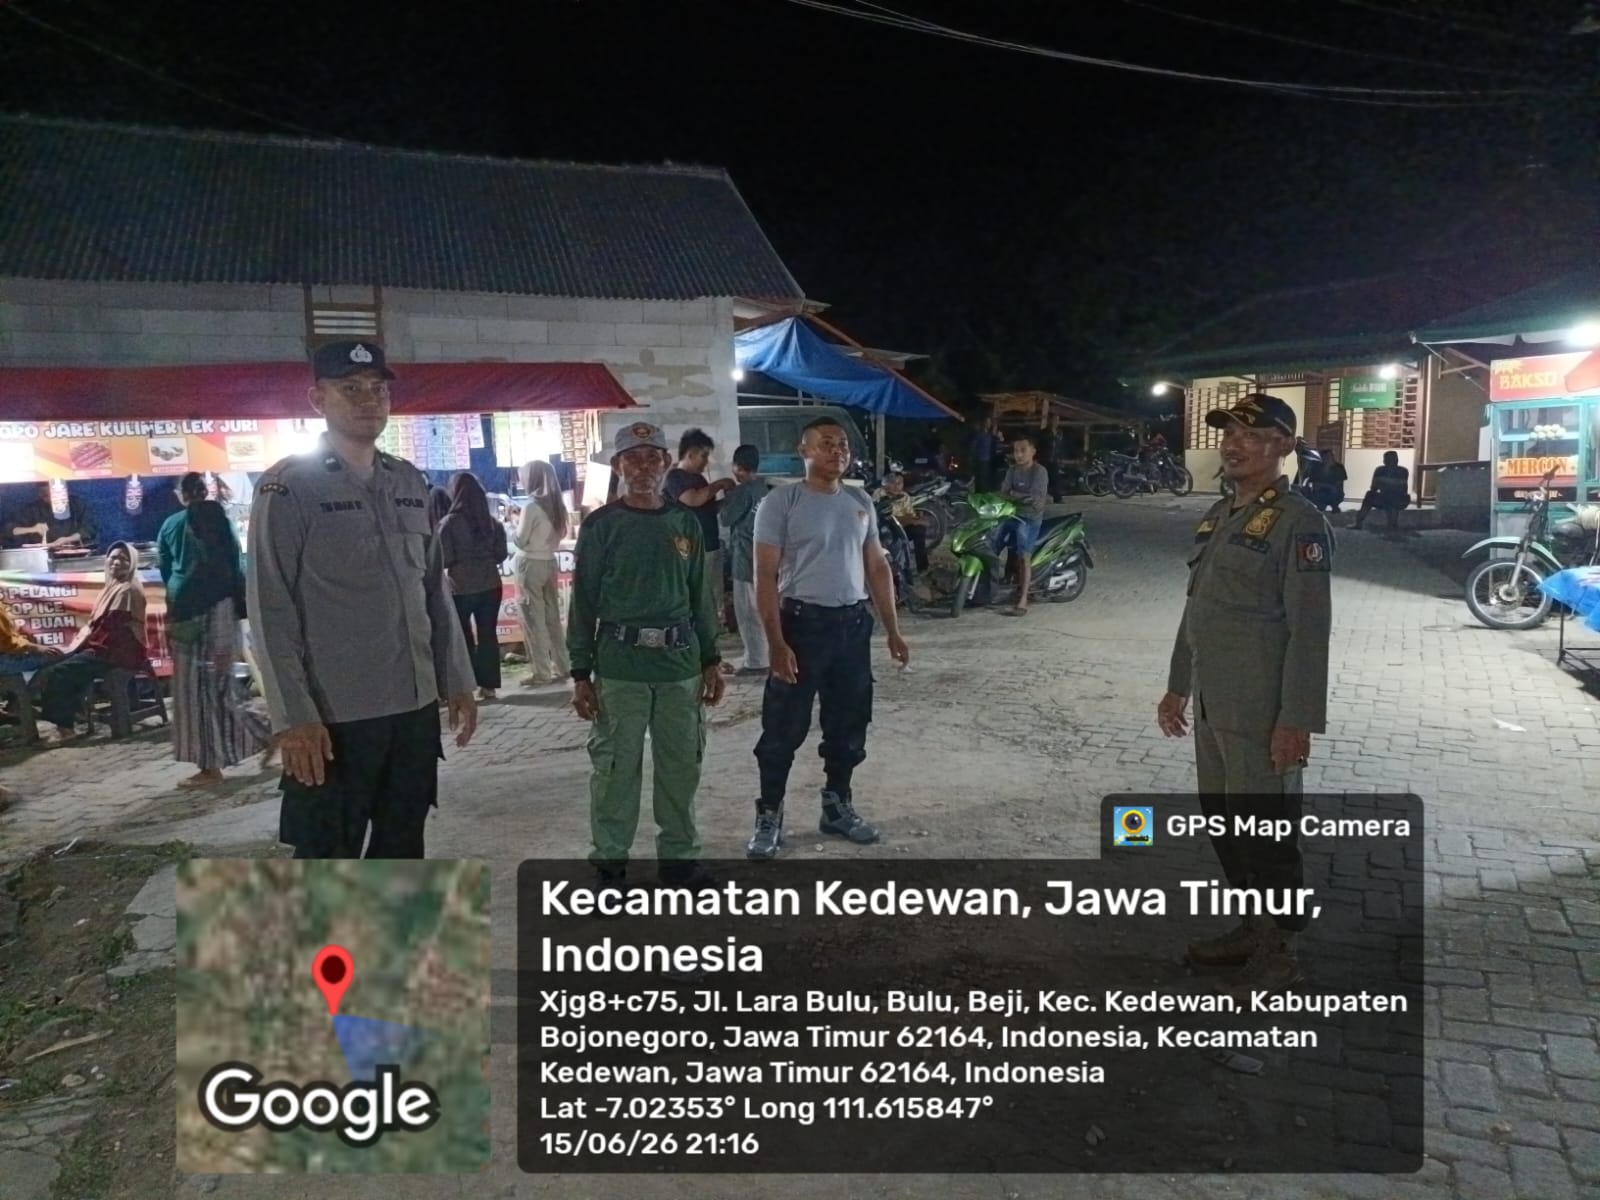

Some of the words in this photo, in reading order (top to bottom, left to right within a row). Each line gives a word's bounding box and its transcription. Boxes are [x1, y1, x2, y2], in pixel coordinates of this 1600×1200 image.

[44, 421, 97, 438] JARE
[182, 419, 214, 434] LEK
[220, 418, 258, 433] JURI
[8, 585, 78, 599] PELANGI
[38, 601, 64, 614] ICE
[31, 616, 75, 630] BUAH
[33, 632, 64, 645] TEH
